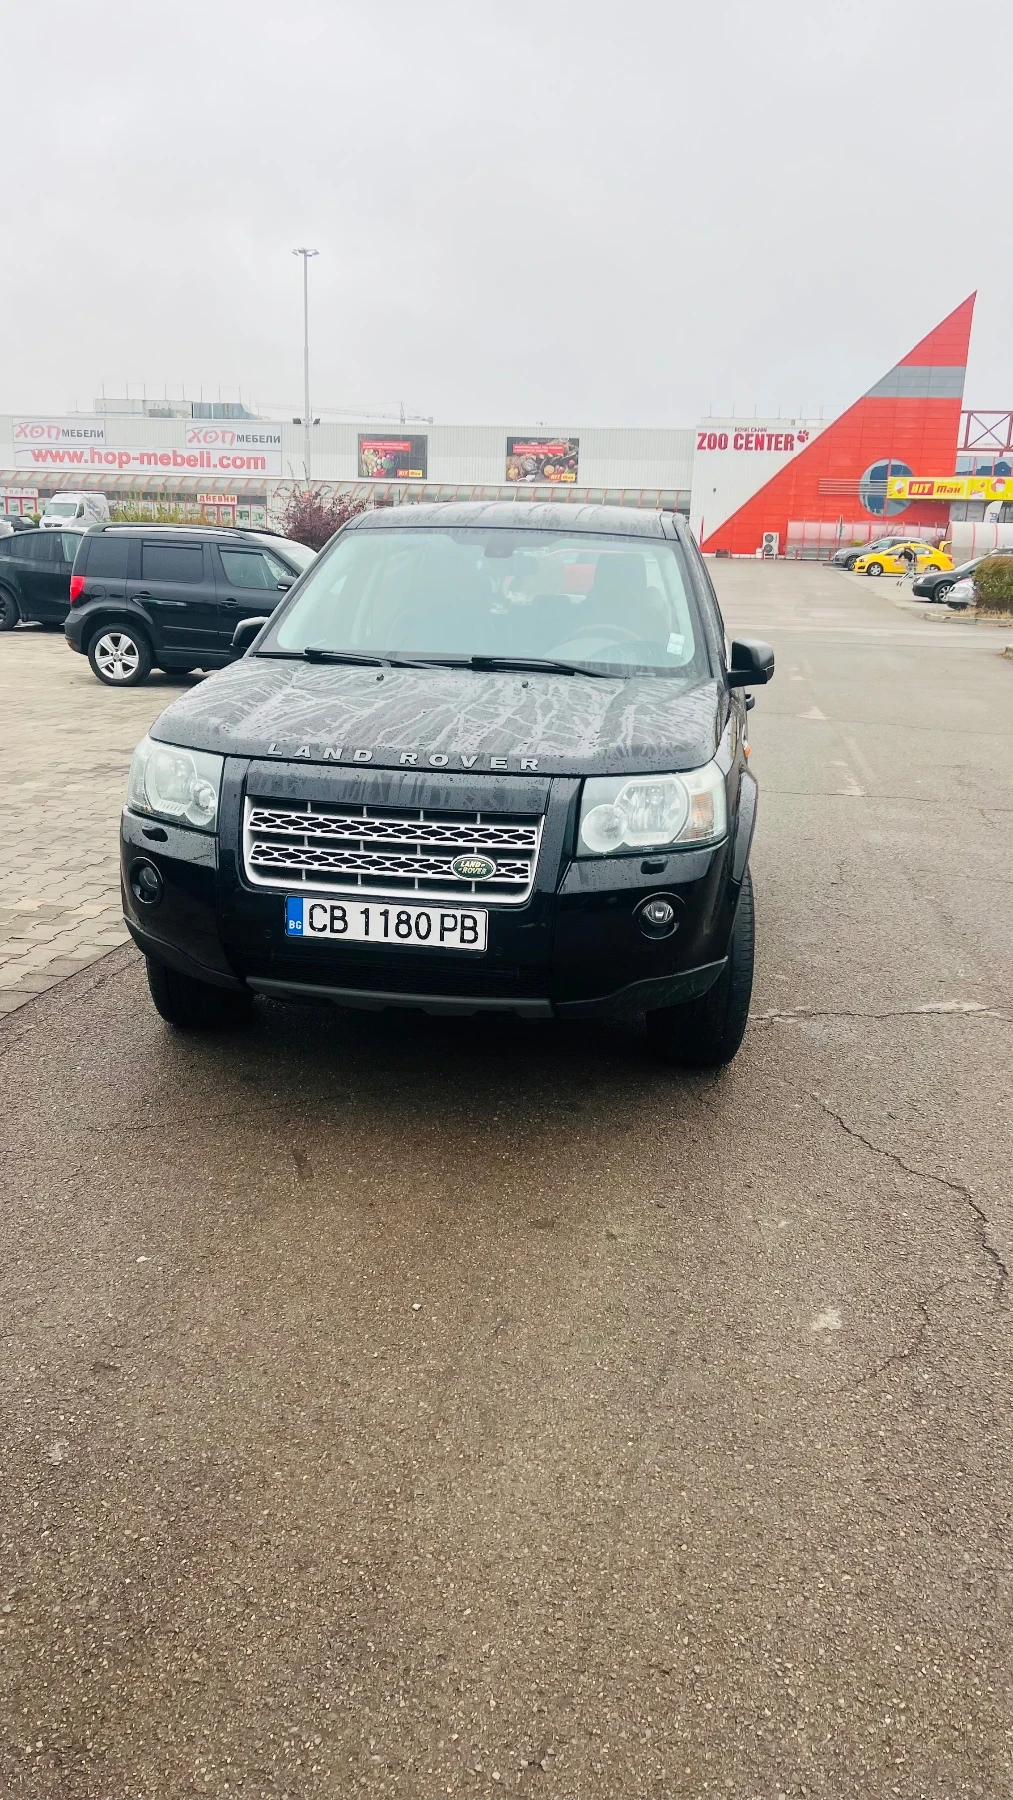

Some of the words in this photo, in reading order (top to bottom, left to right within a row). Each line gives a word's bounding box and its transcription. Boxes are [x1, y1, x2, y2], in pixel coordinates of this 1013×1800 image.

[61, 429, 104, 438] МЕБЕЛИ
[236, 434, 281, 444] МЕБЕЛИ
[697, 433, 728, 451] ZOO
[733, 433, 795, 451] CENTER
[31, 447, 266, 470] www.hop-mebeli.com
[911, 483, 931, 494] HIT
[199, 494, 236, 503] ДНЕВНИ
[266, 742, 374, 763] LAND
[399, 752, 540, 772] ROVER
[288, 920, 302, 930] BG
[308, 903, 348, 934] CB
[359, 907, 432, 940] 1180
[439, 913, 480, 945] PB
